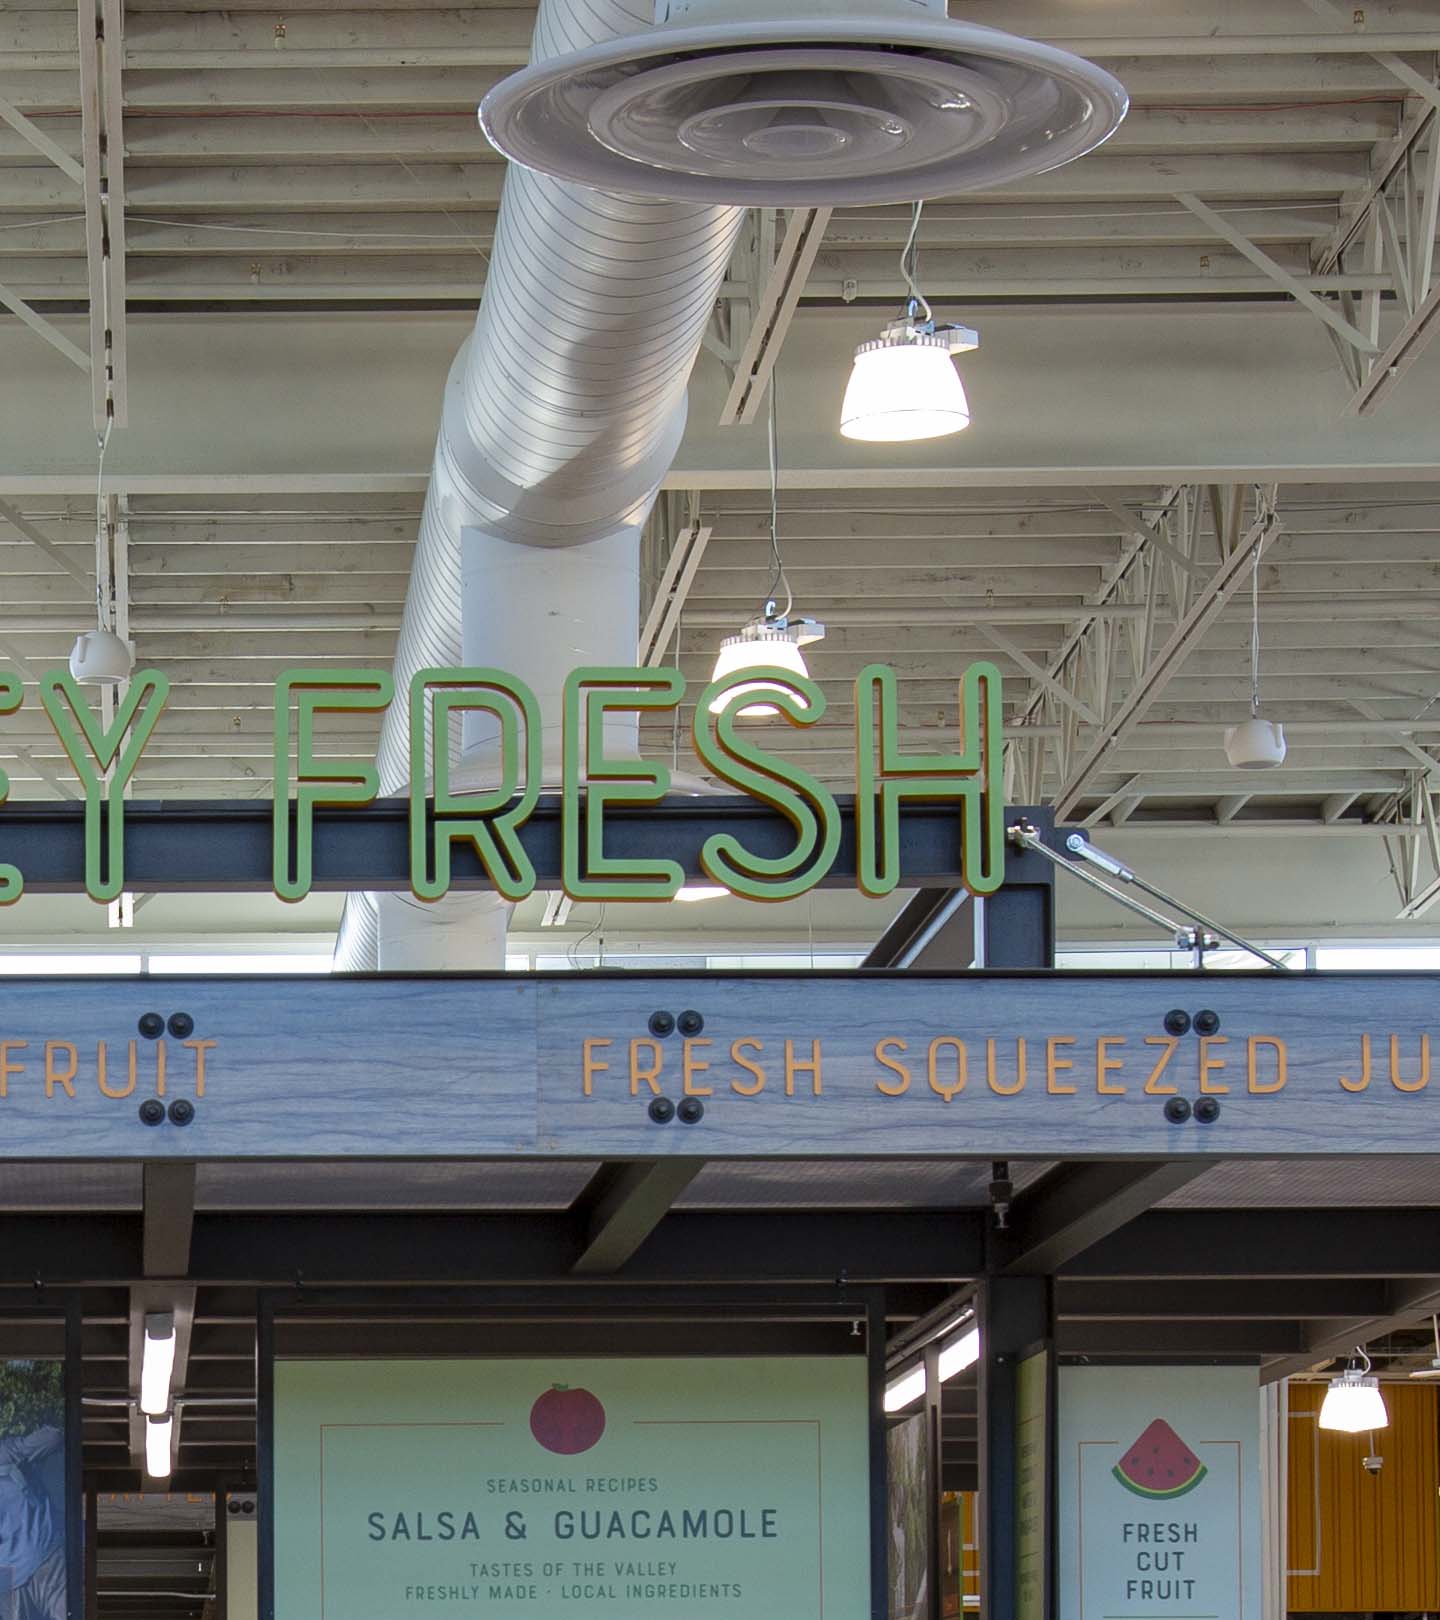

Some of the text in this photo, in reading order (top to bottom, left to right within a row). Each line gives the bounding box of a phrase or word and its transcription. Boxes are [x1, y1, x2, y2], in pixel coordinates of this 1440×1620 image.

[271, 660, 1006, 904] FRESH
[583, 1036, 824, 1096] FRESH
[872, 1035, 1289, 1104] SQUEEZED
[486, 1477, 658, 1494] SEASONAL RECIPES
[368, 1508, 779, 1542] SALSA & GUACAMOLE
[1123, 1523, 1198, 1543] FRESH
[470, 1561, 678, 1578] TASTES OF THE VALLEY
[1136, 1551, 1185, 1572] CUT
[405, 1583, 742, 1601] FRESHLY MADE LOCAL INGREDIENTS
[1126, 1579, 1196, 1600] FRUIT
